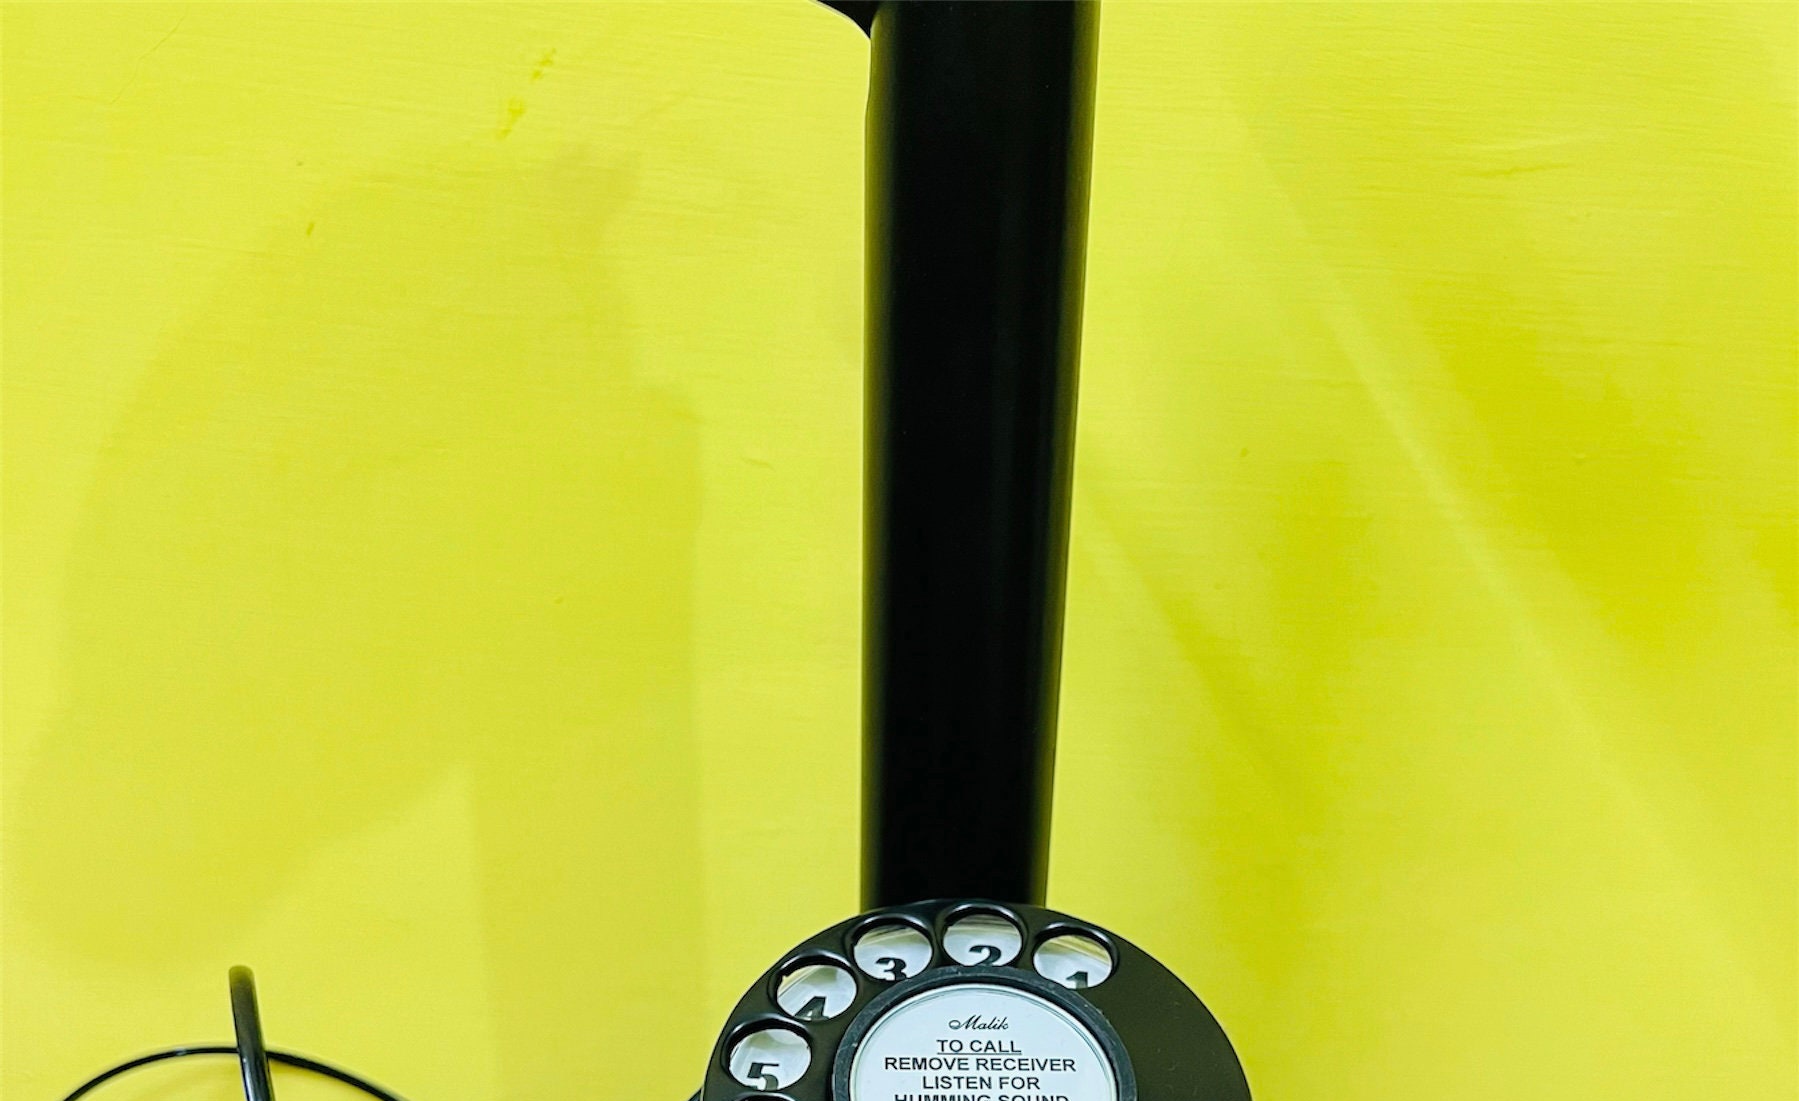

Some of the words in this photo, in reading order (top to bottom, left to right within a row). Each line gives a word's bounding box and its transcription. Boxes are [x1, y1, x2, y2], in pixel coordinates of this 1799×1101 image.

[968, 944, 1002, 967] 2
[874, 957, 908, 981] 3
[948, 1014, 1009, 1031] Malik
[936, 1039, 963, 1053] TO
[969, 1039, 1022, 1053] CALL
[884, 1057, 970, 1071] REMOVE
[976, 1058, 1077, 1072] RECEIVER
[746, 1061, 780, 1091] 5
[922, 1076, 992, 1090] LISTEN
[999, 1076, 1041, 1090] FOR
